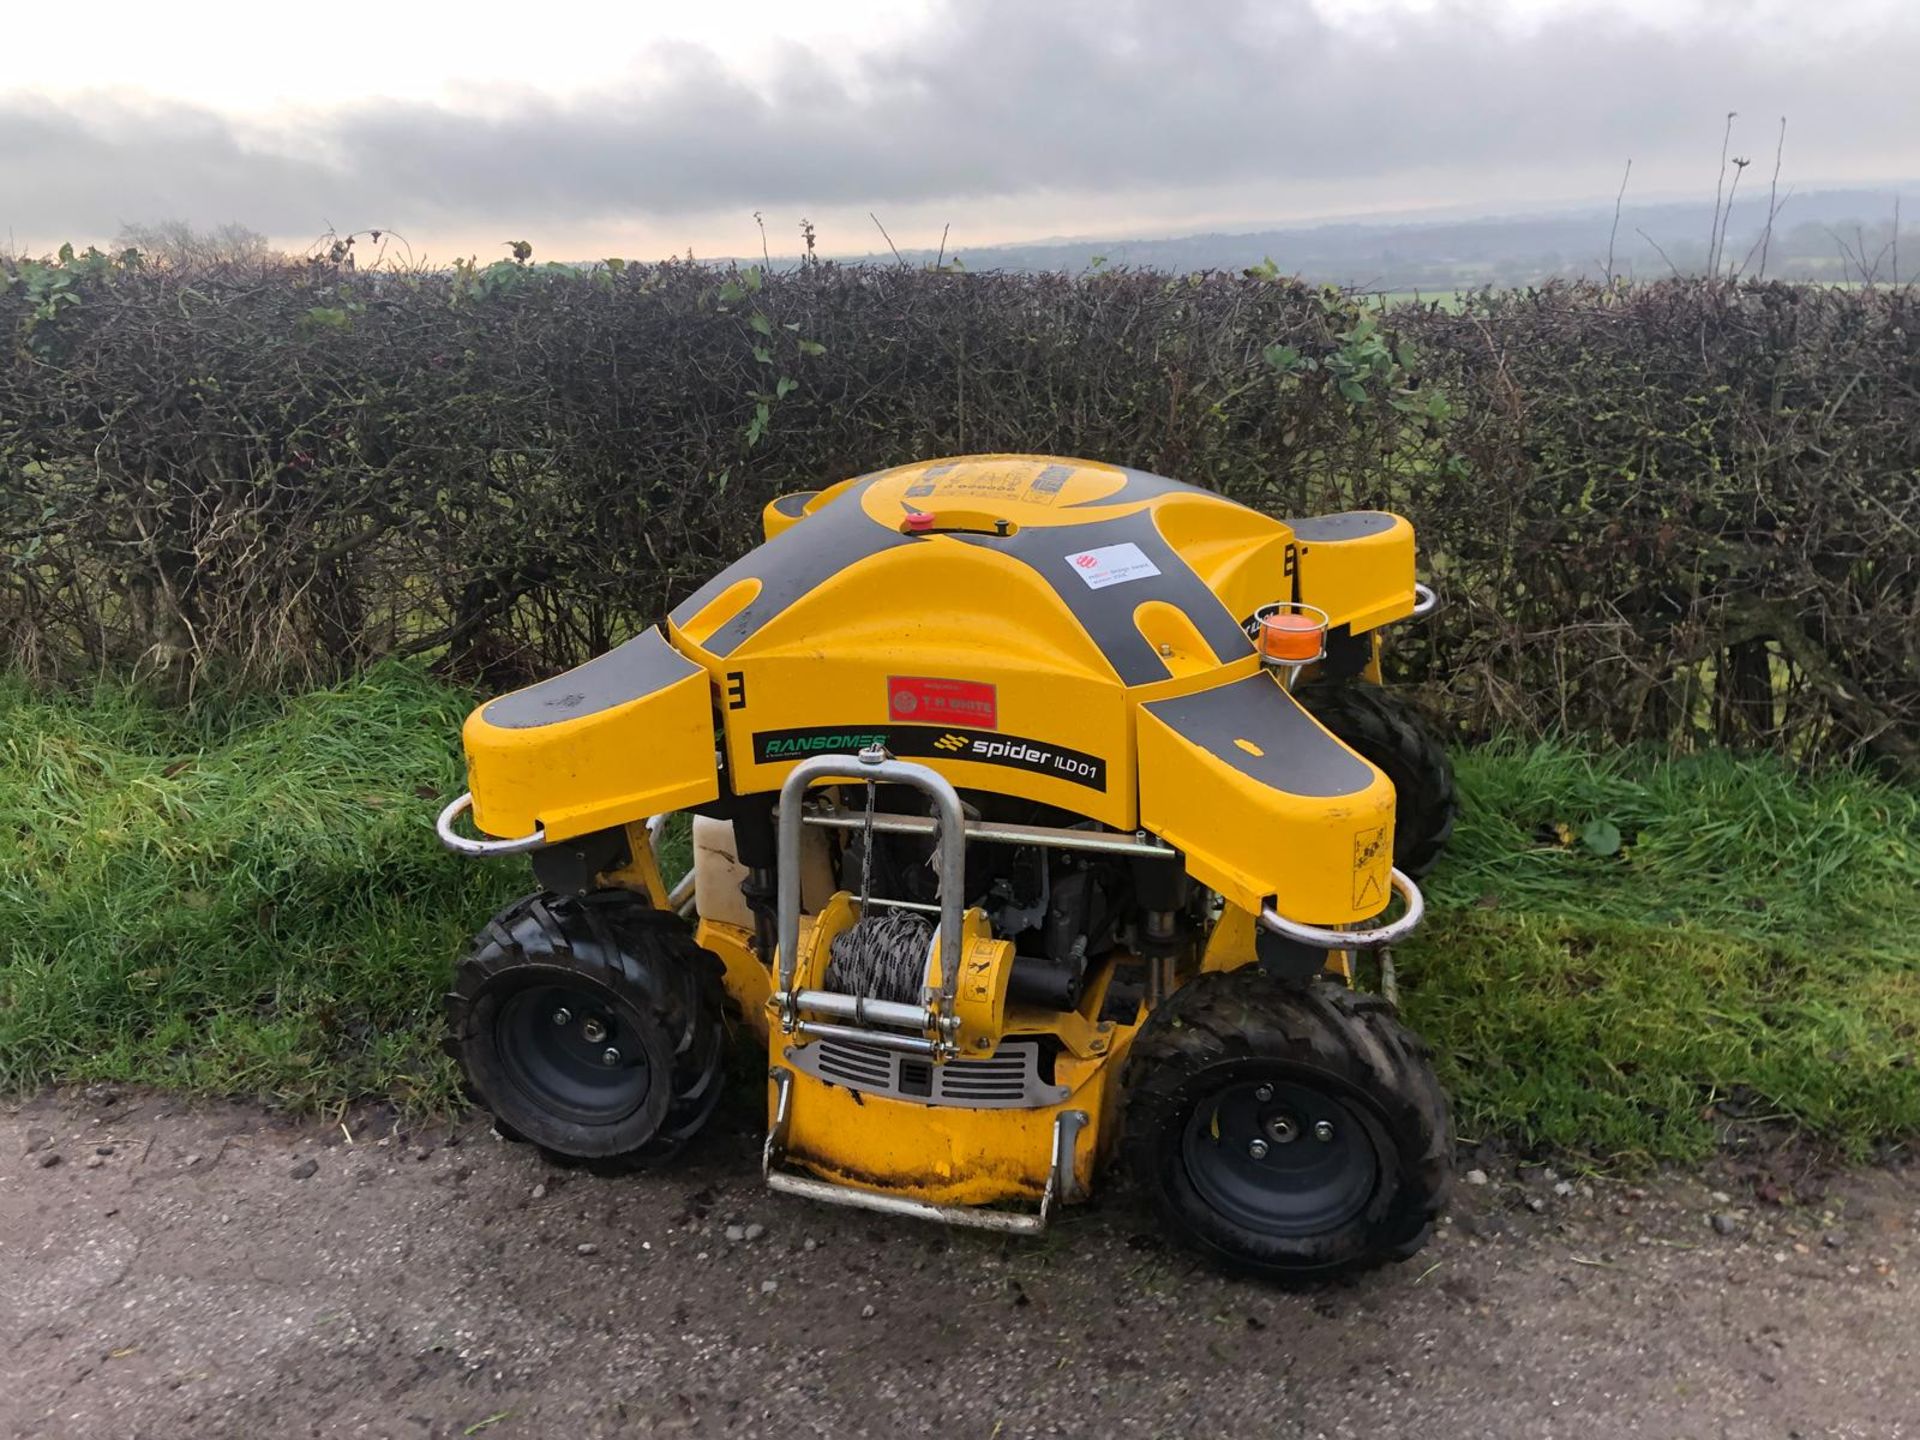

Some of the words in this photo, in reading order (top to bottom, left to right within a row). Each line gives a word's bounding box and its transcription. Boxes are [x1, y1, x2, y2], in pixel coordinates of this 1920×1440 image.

[766, 734, 887, 754] RANSOMES
[972, 741, 1052, 764] spider
[1054, 756, 1097, 779] ILD01
